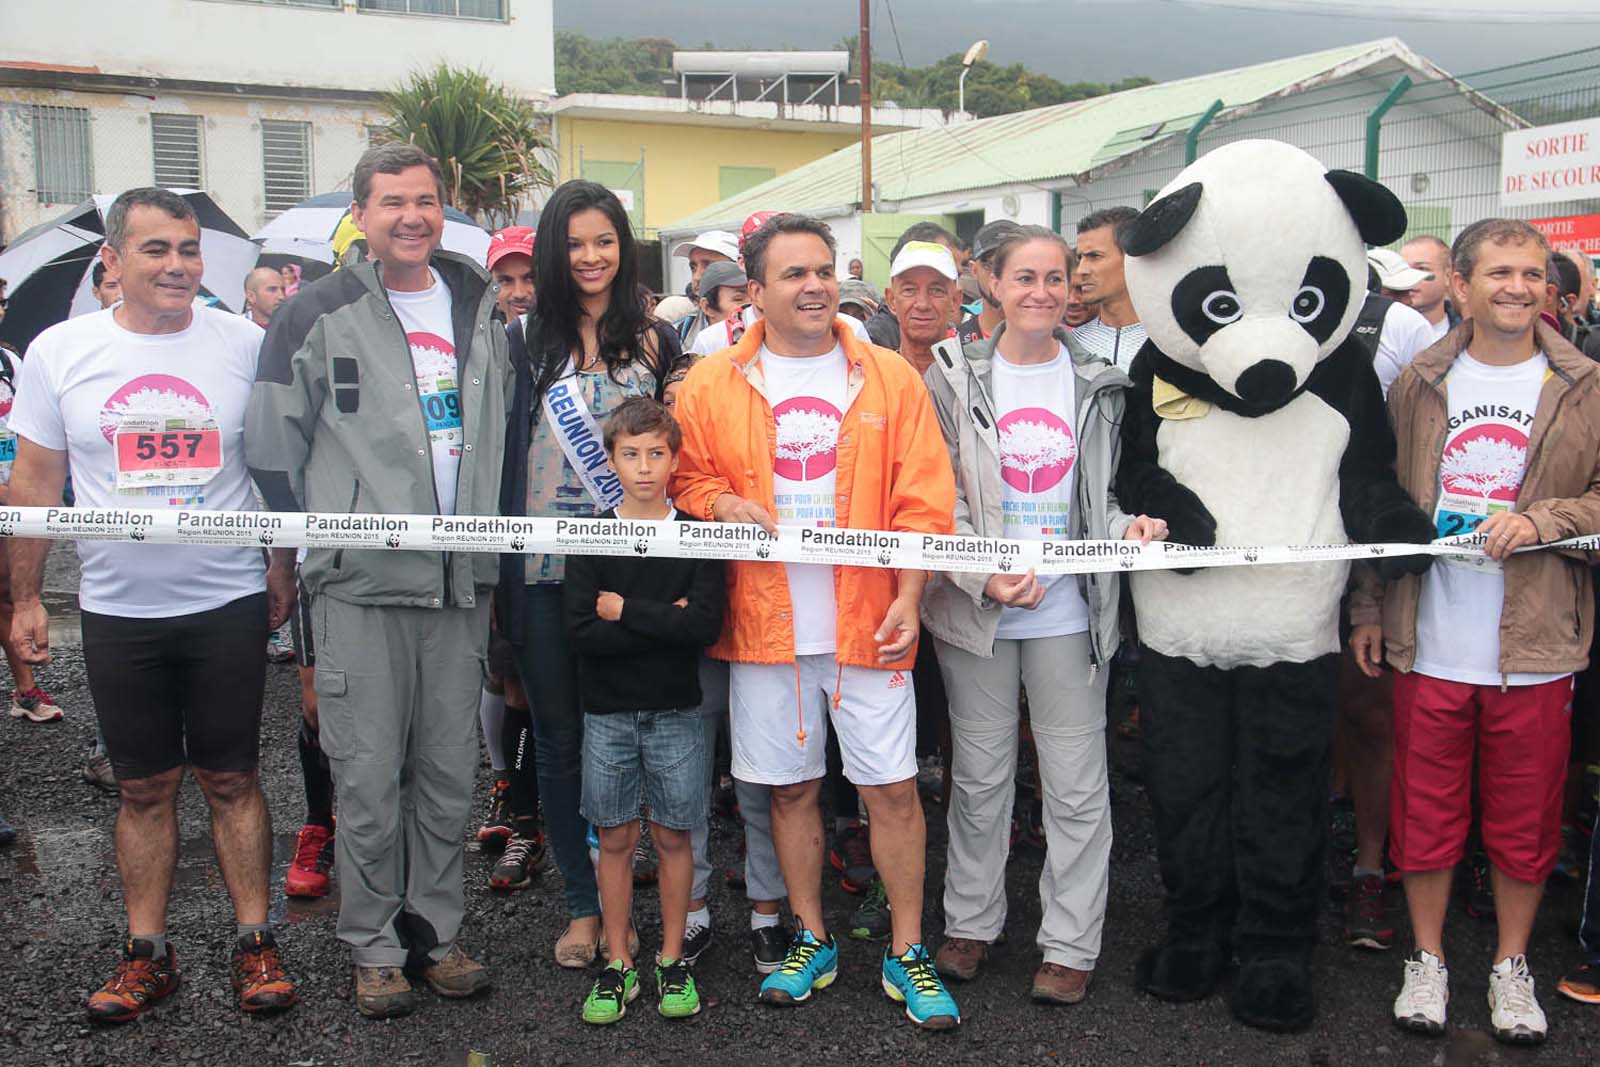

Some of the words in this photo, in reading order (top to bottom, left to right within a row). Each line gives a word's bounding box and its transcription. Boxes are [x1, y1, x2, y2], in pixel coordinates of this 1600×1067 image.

[1526, 133, 1588, 159] SORTIE
[1506, 174, 1527, 193] DE
[1535, 221, 1575, 234] ORTIE
[1448, 405, 1534, 431] GANISAT
[136, 433, 203, 460] 557
[546, 383, 608, 472] REUNION
[593, 469, 624, 508] 201
[47, 509, 153, 525] Pandathlon
[178, 512, 281, 528] Pandathlon
[305, 515, 408, 531] Pandathlon
[432, 518, 533, 534] Pandathlon
[556, 520, 656, 537] Pandathlon
[801, 528, 900, 548] Pandathlon
[922, 536, 1020, 555] Pandathlon
[1043, 542, 1141, 556] Pandathlon
[515, 728, 528, 770] SALOMON
